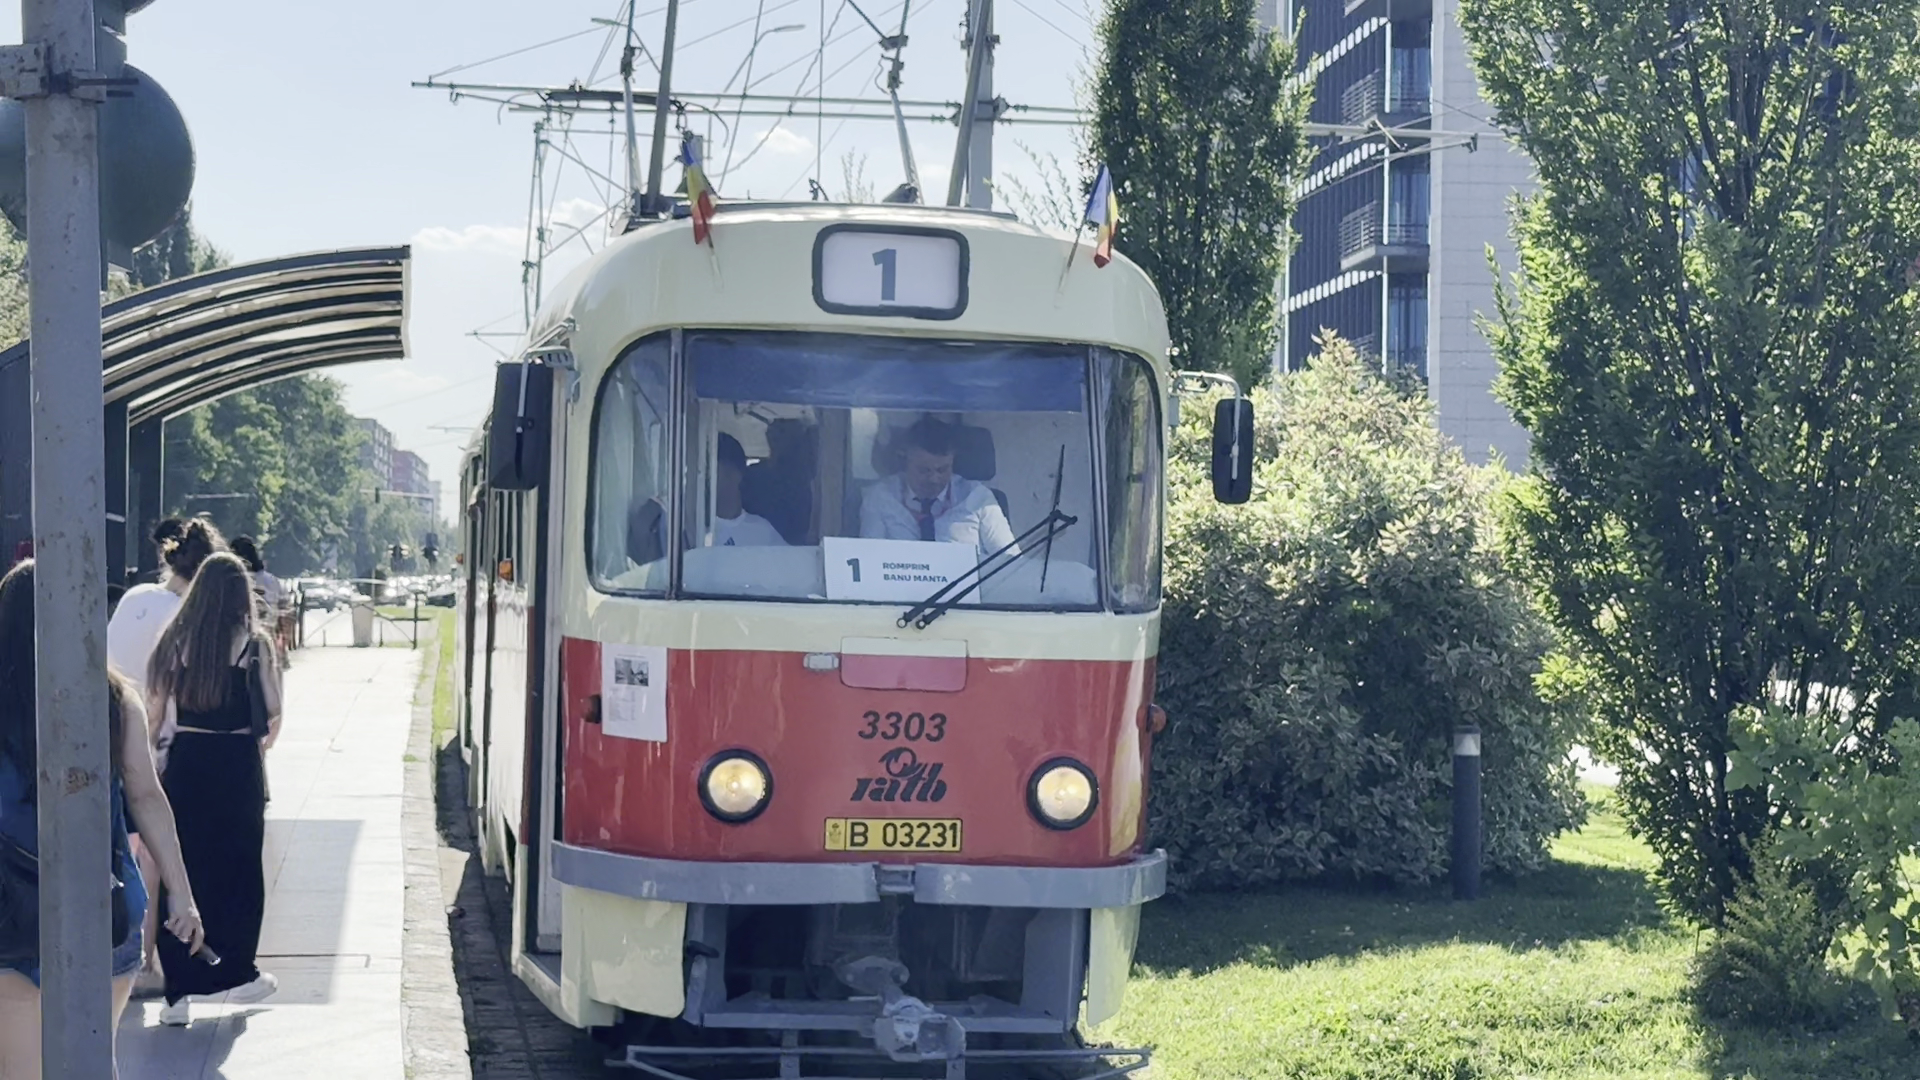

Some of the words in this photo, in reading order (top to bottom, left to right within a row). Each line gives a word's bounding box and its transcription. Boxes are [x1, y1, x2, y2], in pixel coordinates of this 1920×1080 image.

[872, 248, 897, 301] 1
[846, 558, 861, 583] 1
[882, 562, 930, 571] ROMPRIM
[883, 573, 912, 582] BANU
[913, 575, 948, 583] MANTA
[858, 710, 947, 742] 3303
[850, 822, 869, 847] B
[882, 822, 958, 848] 03231
